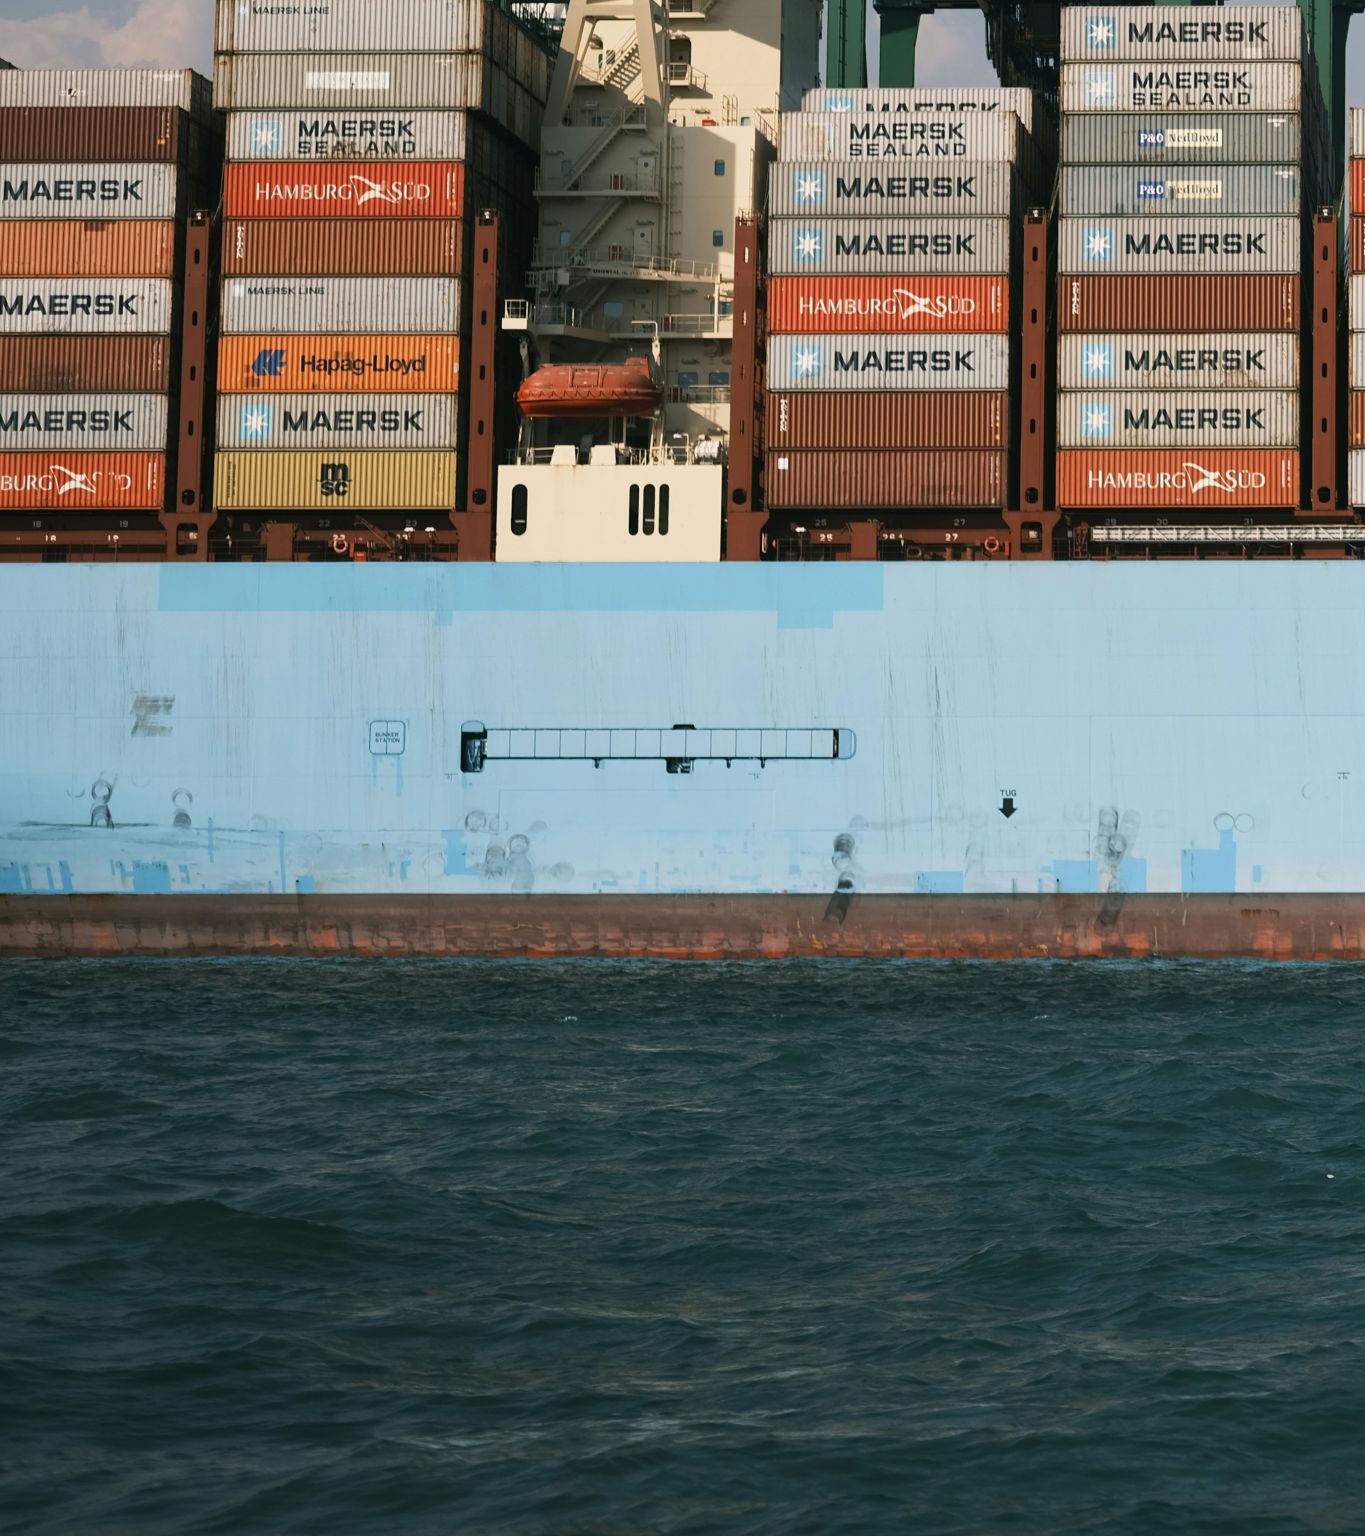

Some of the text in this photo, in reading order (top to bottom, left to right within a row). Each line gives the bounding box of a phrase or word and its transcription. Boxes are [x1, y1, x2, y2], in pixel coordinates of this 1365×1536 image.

[252, 6, 329, 15] MAERSK LINE
[1128, 22, 1269, 42] MAERSK
[1132, 72, 1249, 89] MAERSK
[1133, 92, 1251, 105] SEALAND
[298, 120, 414, 137] MAERSK
[850, 122, 965, 139] MAERSK
[1140, 131, 1219, 144] P&O Nedlloyd
[298, 141, 415, 155] SEALAND
[850, 143, 967, 156] SEALAND
[2, 180, 143, 201] MAERSK
[256, 179, 430, 201] HAMBURG SÜD
[836, 177, 976, 198] MAERSK
[1139, 184, 1164, 195] P&O
[836, 234, 976, 255] MAERSK
[1125, 233, 1267, 255] MAERSK
[248, 287, 325, 295] MAERSK LINE
[0, 295, 138, 315] MAERSK
[800, 295, 976, 315] HAMBURG SÜD
[301, 354, 426, 376] Hapag-Lloyd
[834, 351, 975, 372] MAERSK
[1124, 350, 1266, 371] MAERSK
[283, 410, 423, 432] MAERSK
[1124, 408, 1266, 429] MAERSK
[1089, 468, 1265, 488] HAMBURG SÜD
